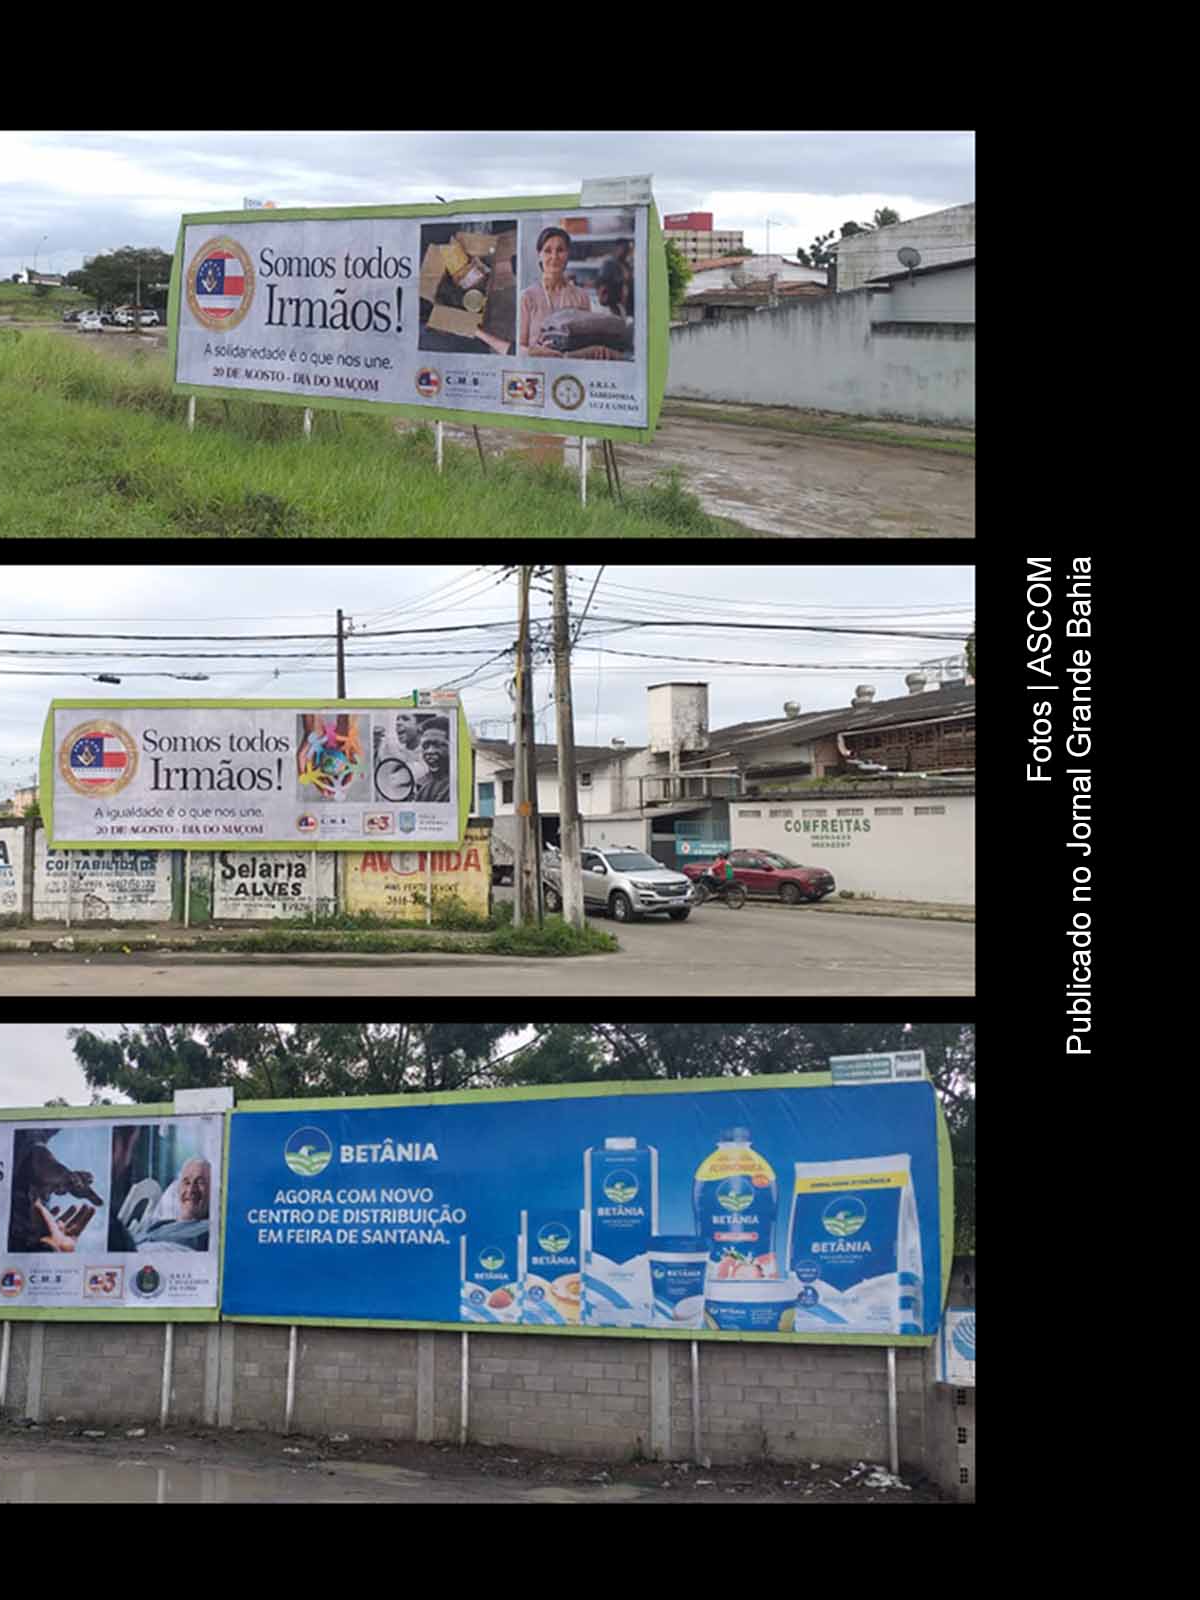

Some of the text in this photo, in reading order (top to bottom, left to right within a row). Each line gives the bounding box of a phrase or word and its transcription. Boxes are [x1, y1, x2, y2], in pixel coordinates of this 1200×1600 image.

[259, 247, 411, 279] Somos todos
[265, 284, 403, 333] Irmãos!
[204, 343, 393, 369] A solidariedade é o que nos une.
[213, 367, 378, 392] 20 DE AGOSTO DIA DO MAÇOM
[143, 729, 289, 753] Somos todos
[150, 758, 283, 791] Irmãos!
[94, 809, 102, 818] A
[107, 807, 163, 819] igualdade
[167, 807, 174, 817] é
[189, 809, 211, 819] que
[240, 809, 264, 817] une.
[96, 826, 108, 835] 20
[111, 826, 126, 834] DE
[130, 826, 174, 834] AGOSTO
[202, 825, 219, 834] DO
[222, 825, 263, 835] MAÇOM
[235, 882, 302, 896] ALVES
[340, 1138, 438, 1163] BETÂNIA
[274, 1188, 433, 1204] AGORA COM NOVO
[248, 1205, 466, 1227] CENTRO DE DISTRIBUIÇÃO
[258, 1230, 450, 1244] EM FEIRA DE SANTANA.
[811, 1238, 872, 1253] BETÂNIA
